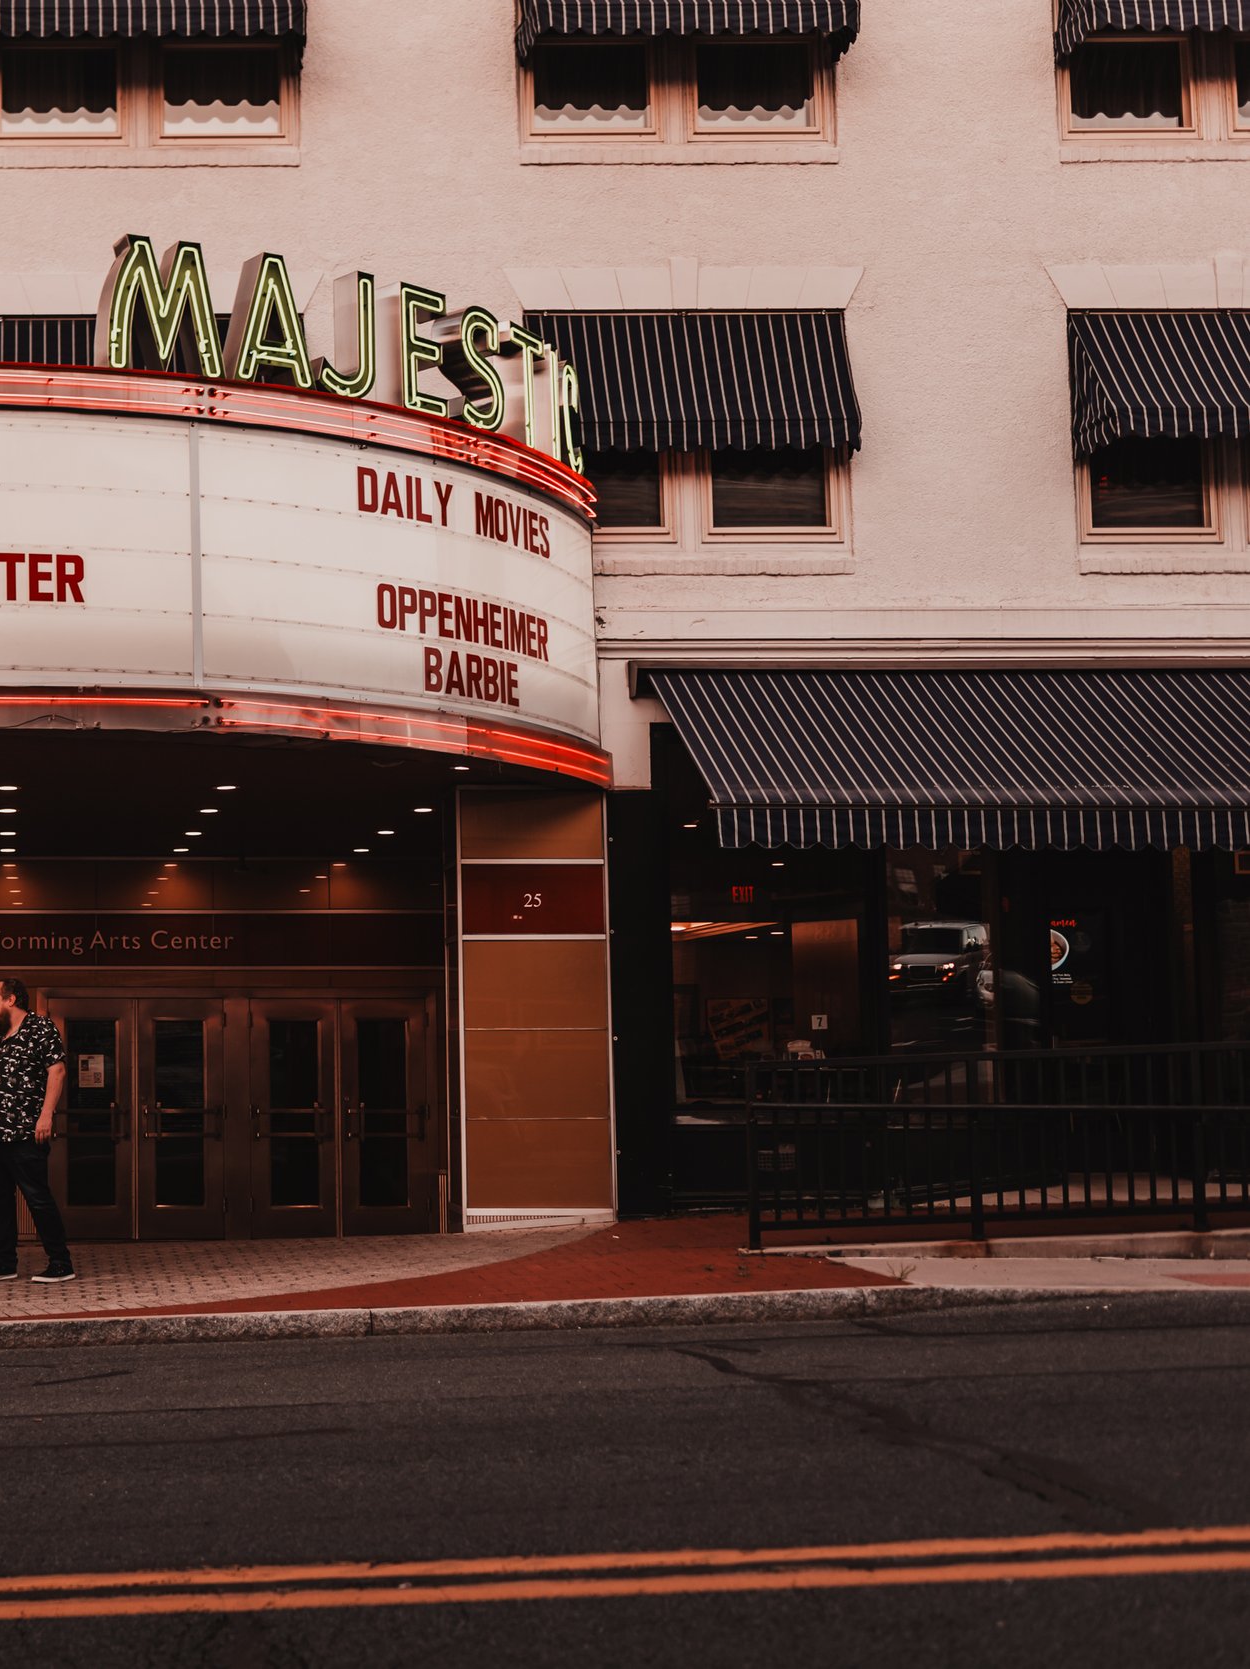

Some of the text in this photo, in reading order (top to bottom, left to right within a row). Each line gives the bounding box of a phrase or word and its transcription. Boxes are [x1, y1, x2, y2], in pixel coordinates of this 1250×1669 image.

[106, 234, 585, 475] MAJESTIC
[357, 466, 550, 559] DAILY MOVIES
[377, 583, 549, 662] OPPENHEIMER
[424, 646, 520, 707] BARBIE
[524, 893, 542, 908] 25
[732, 886, 754, 903] EXIT
[89, 930, 141, 950] Arts
[150, 930, 234, 950] Center
[816, 1016, 824, 1027] 7
